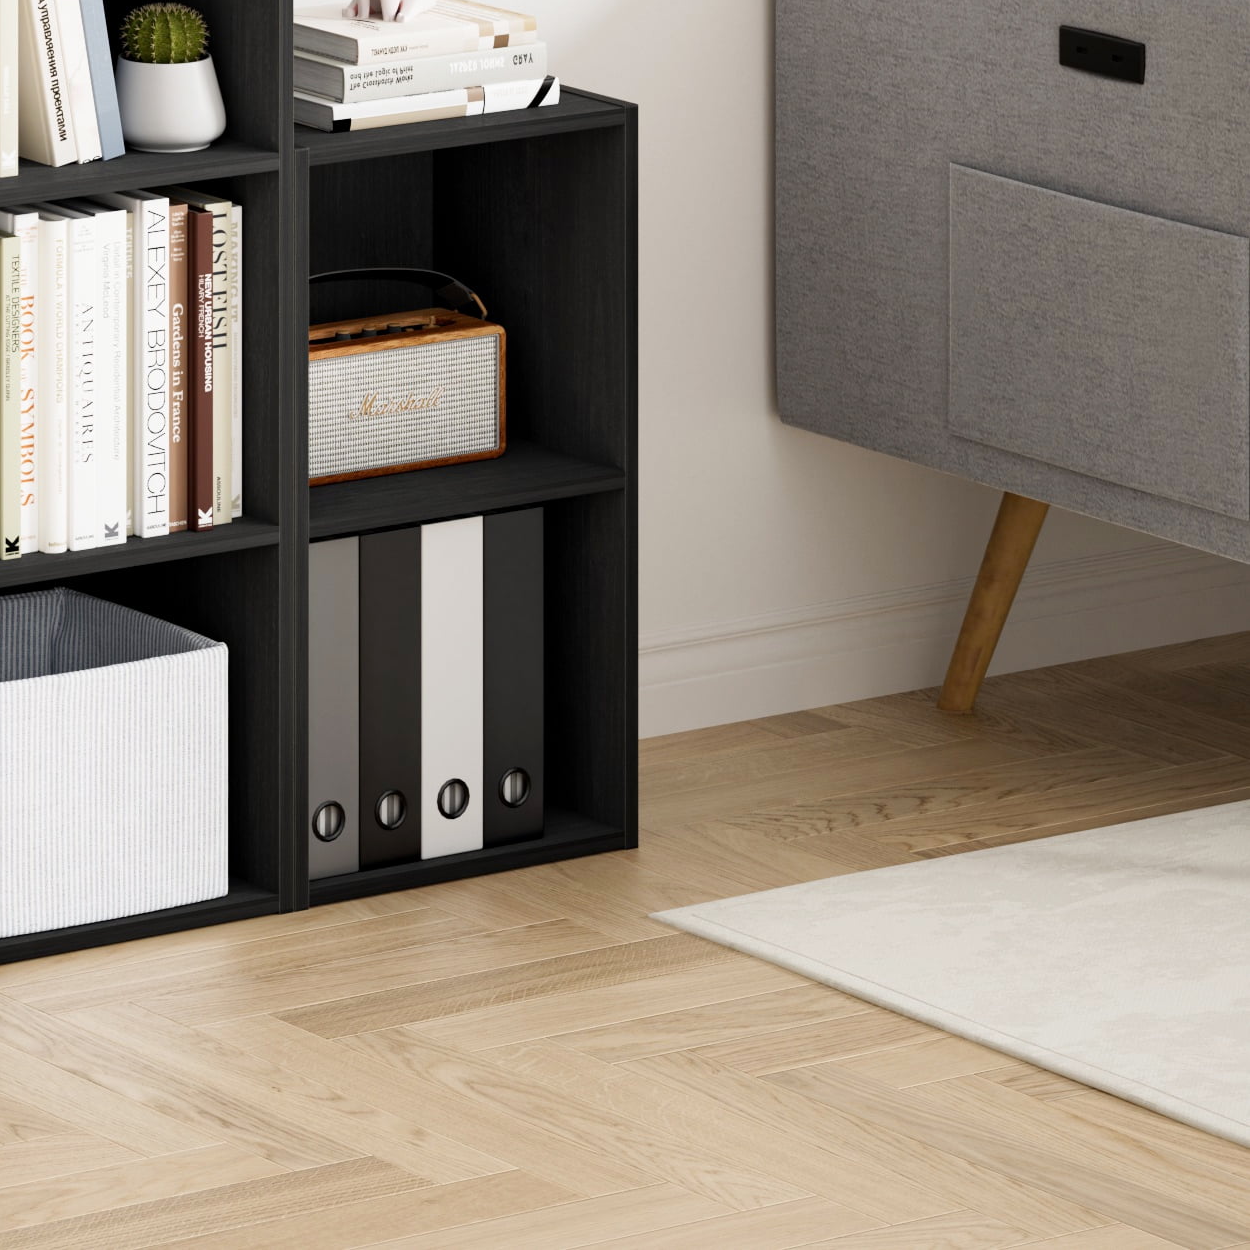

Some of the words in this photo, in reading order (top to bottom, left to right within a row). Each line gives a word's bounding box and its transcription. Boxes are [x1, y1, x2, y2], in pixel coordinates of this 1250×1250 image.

[37, 4, 58, 77] управления
[49, 79, 67, 142] проектами
[11, 255, 20, 293] TEXTILE
[147, 211, 165, 318] ALEXEY
[204, 273, 212, 298] NEW
[11, 297, 20, 353] DESIGNERS
[21, 295, 35, 360] BOOK
[171, 303, 183, 367] Gardens
[204, 301, 212, 340] URBAN
[171, 371, 183, 386] in
[204, 342, 213, 392] HOUSING
[147, 329, 166, 515] BRODOVITCH
[171, 390, 183, 443] France
[350, 386, 446, 419] Marshall
